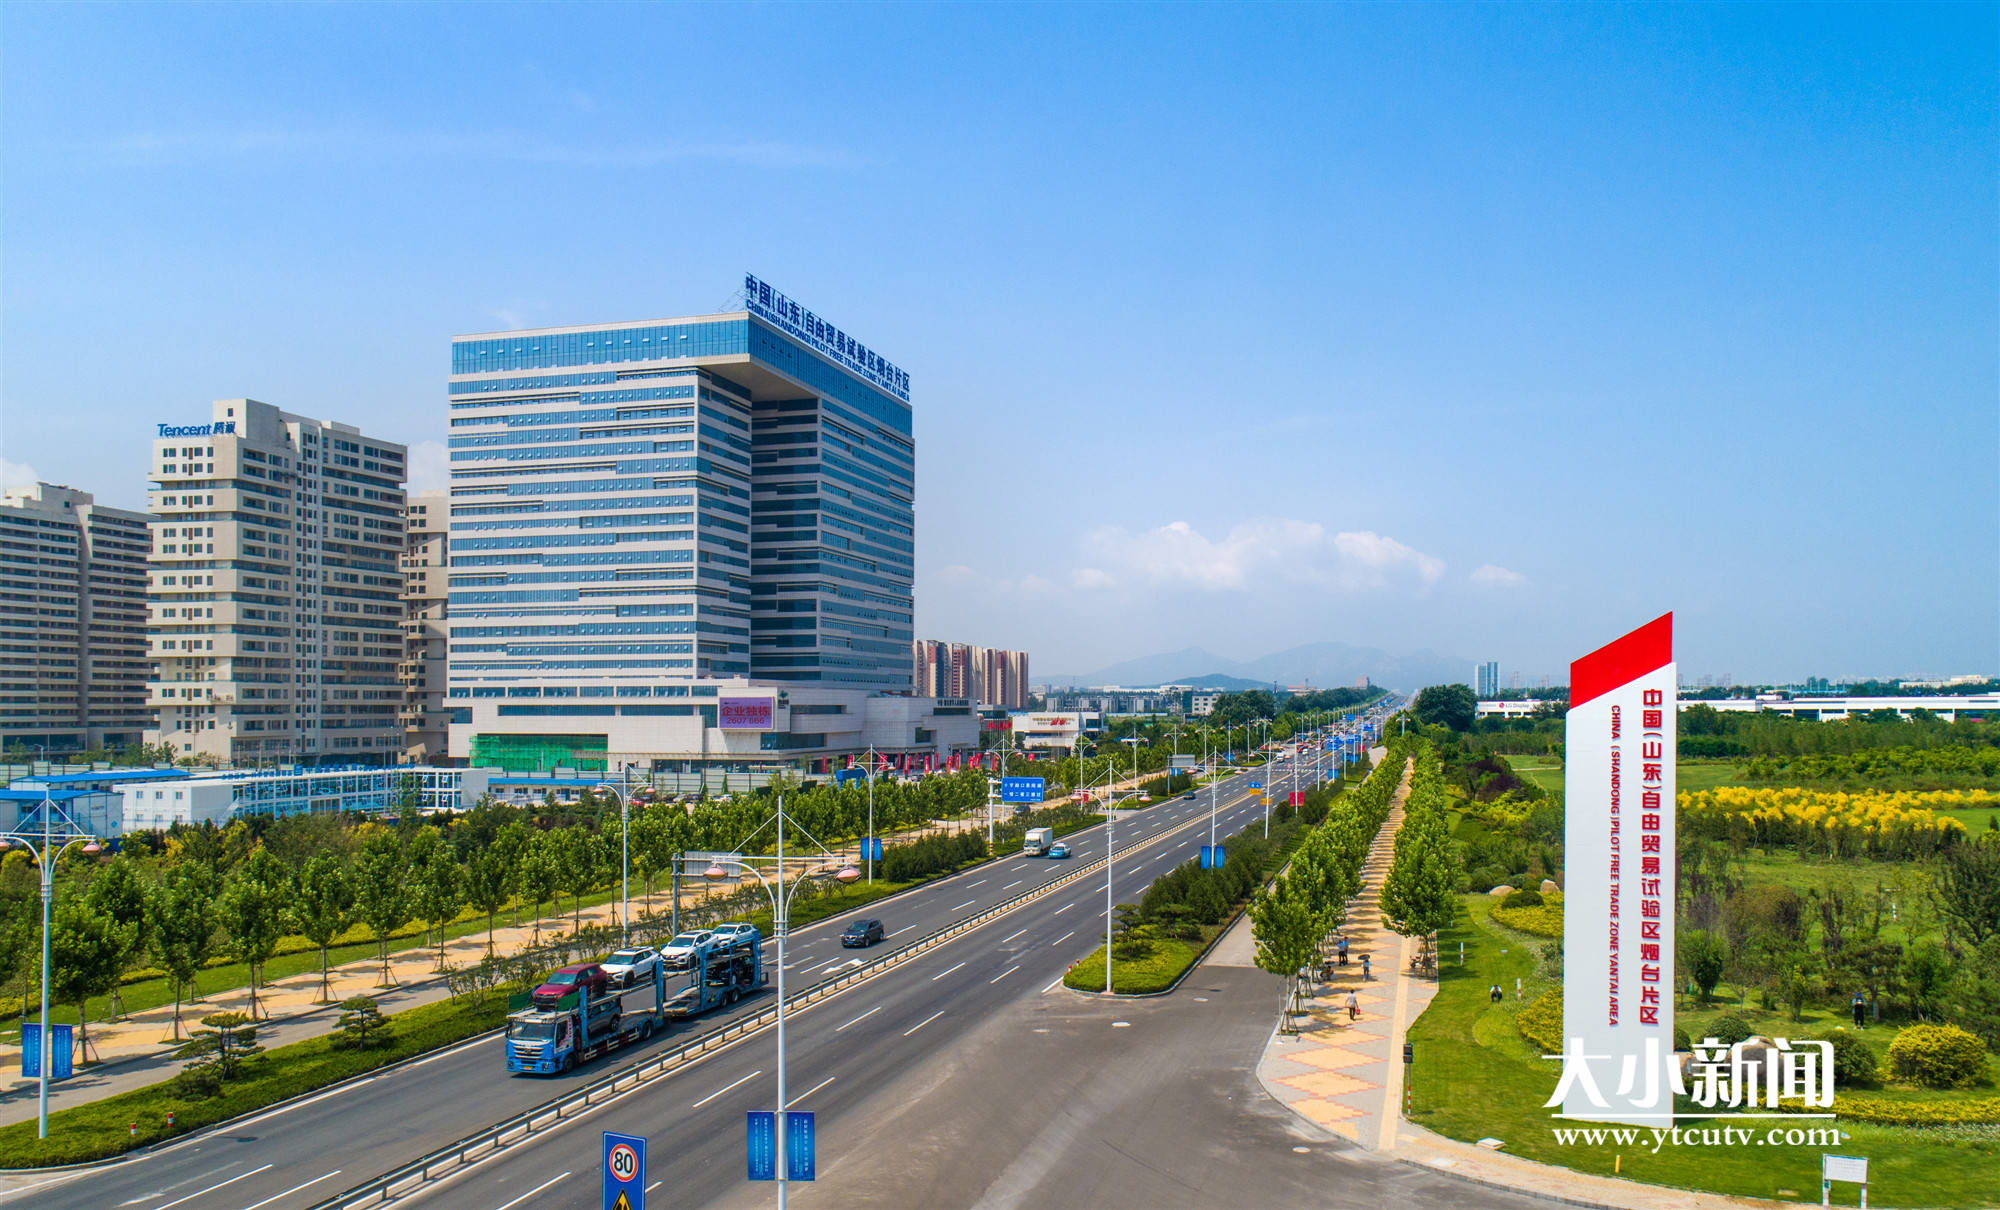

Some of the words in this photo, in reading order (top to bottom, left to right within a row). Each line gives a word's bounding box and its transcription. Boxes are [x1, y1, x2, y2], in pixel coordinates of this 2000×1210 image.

[830, 348, 844, 364] FREE
[845, 357, 863, 375] TRADE
[157, 423, 211, 438] Tencent
[1611, 705, 1621, 740] CHINA
[1610, 854, 1620, 880] FREE
[1610, 883, 1620, 918] TRADE
[1609, 921, 1619, 950] ZONE
[1609, 953, 1619, 993] YANTAI
[1609, 996, 1619, 1026] AREA
[614, 1151, 633, 1174] 80
